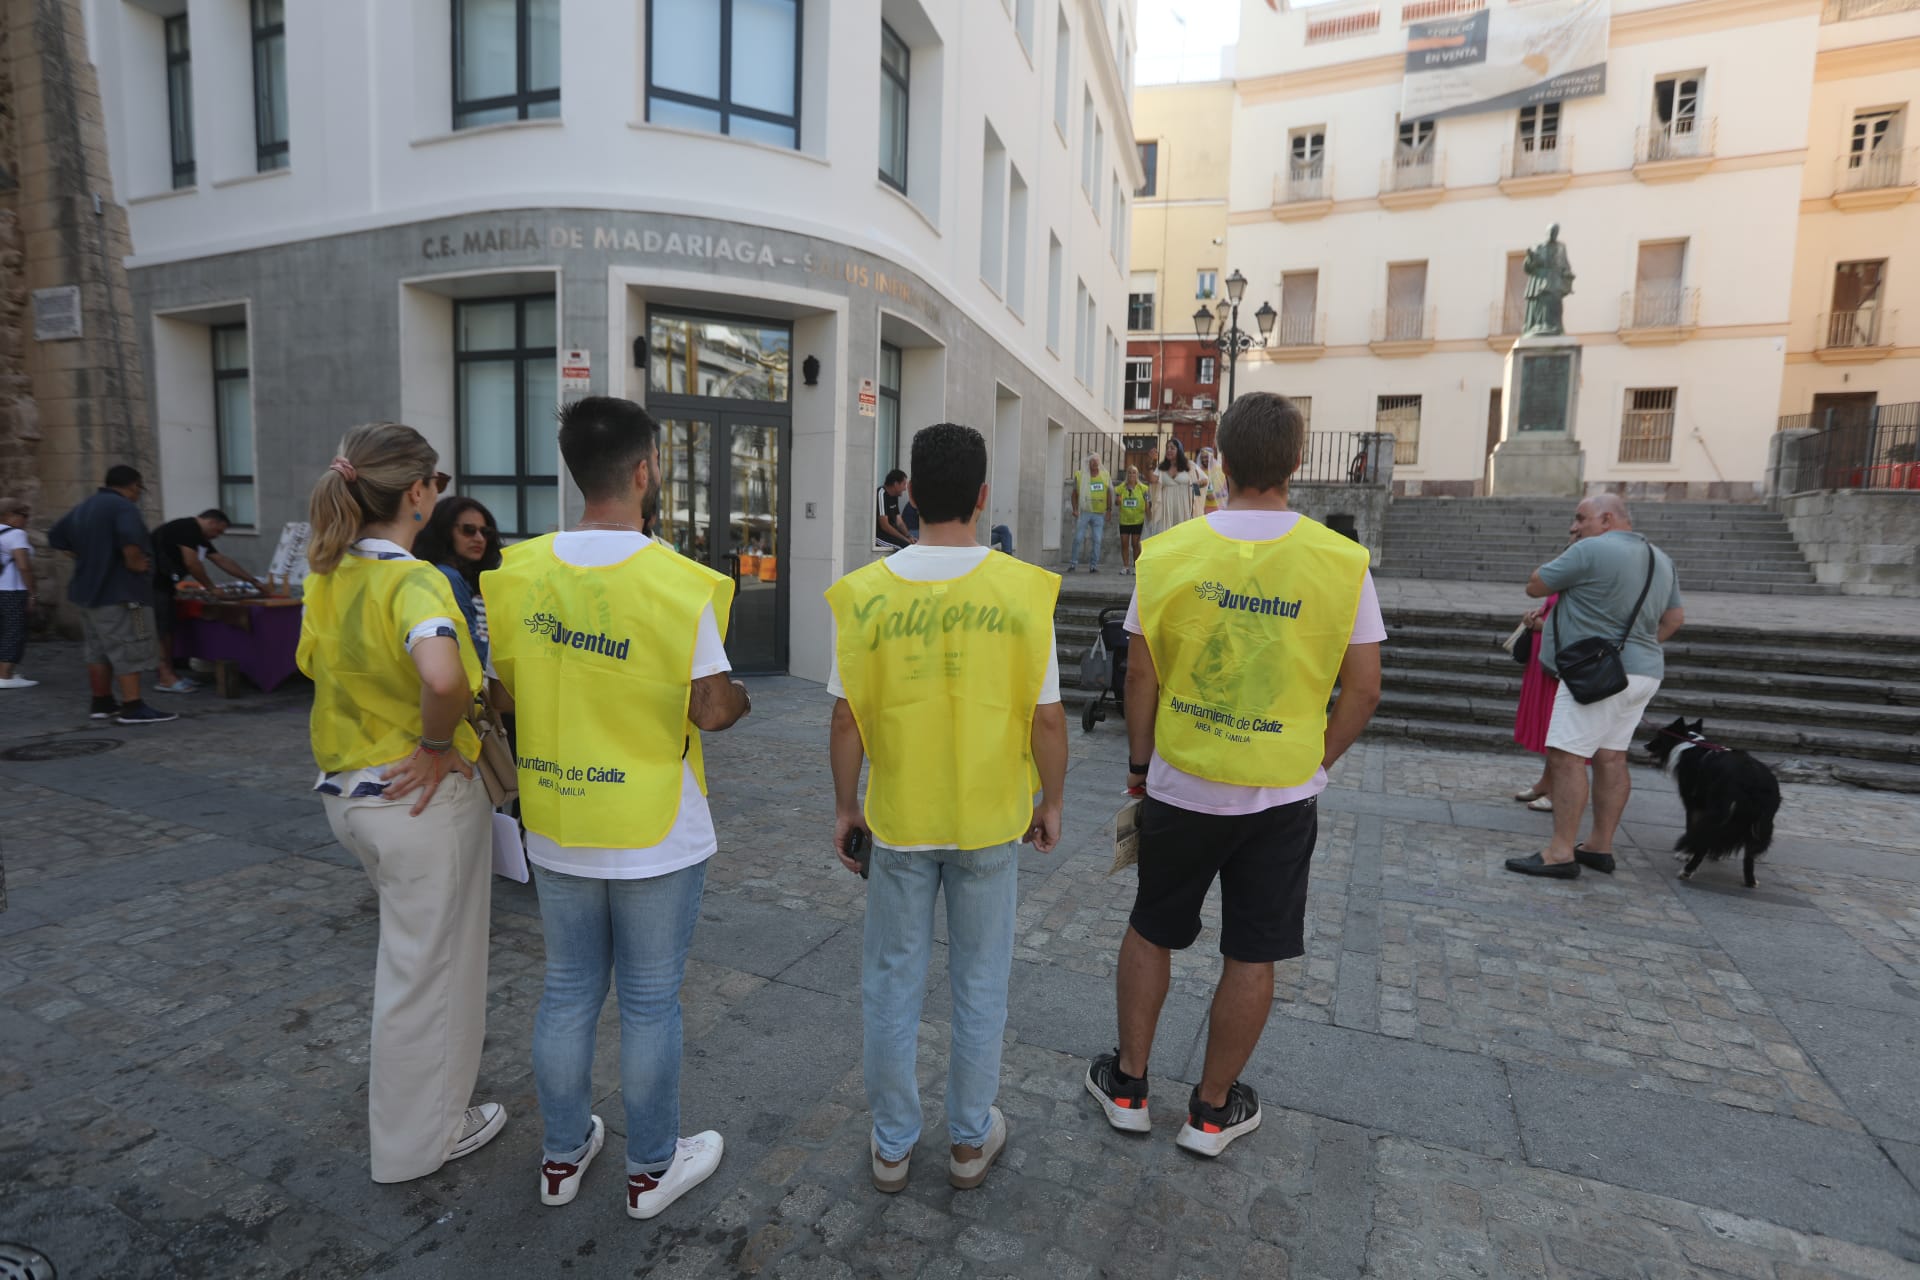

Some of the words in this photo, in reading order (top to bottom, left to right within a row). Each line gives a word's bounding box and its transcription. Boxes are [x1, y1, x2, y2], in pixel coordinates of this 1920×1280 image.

[1425, 51, 1440, 64] EN
[1442, 47, 1478, 62] VENTA
[421, 233, 457, 261] C.E.
[462, 219, 541, 254] MARÍA
[551, 226, 584, 248] DE
[594, 227, 776, 267] MADARIAGA
[1218, 589, 1303, 620] Juventud
[1170, 696, 1236, 729] Ayuntamiento
[1236, 717, 1251, 731] de
[1252, 718, 1284, 734] Cádiz
[566, 766, 584, 781] de
[586, 766, 626, 784] Cádiz
